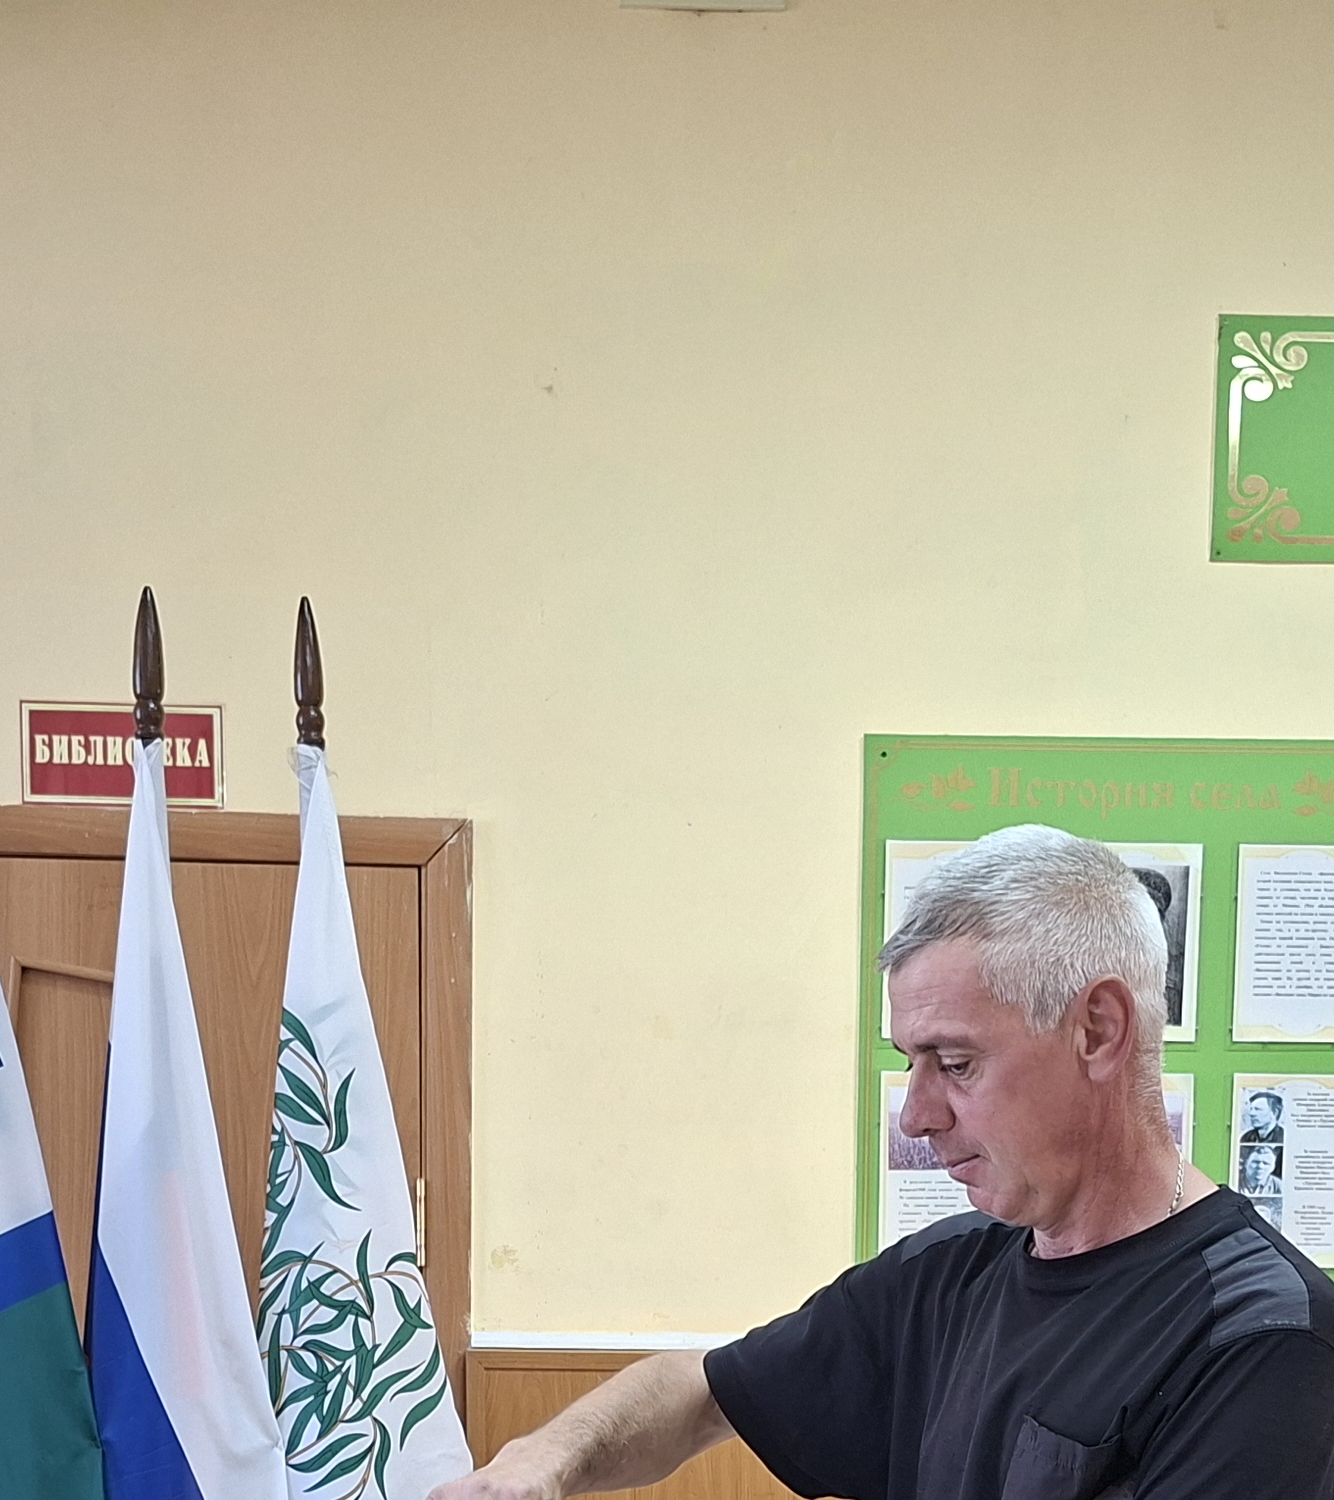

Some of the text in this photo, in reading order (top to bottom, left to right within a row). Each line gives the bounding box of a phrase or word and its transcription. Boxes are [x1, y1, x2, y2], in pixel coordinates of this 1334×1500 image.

[34, 733, 211, 768] БИБЛИОЕКА
[986, 766, 1283, 819] История села
